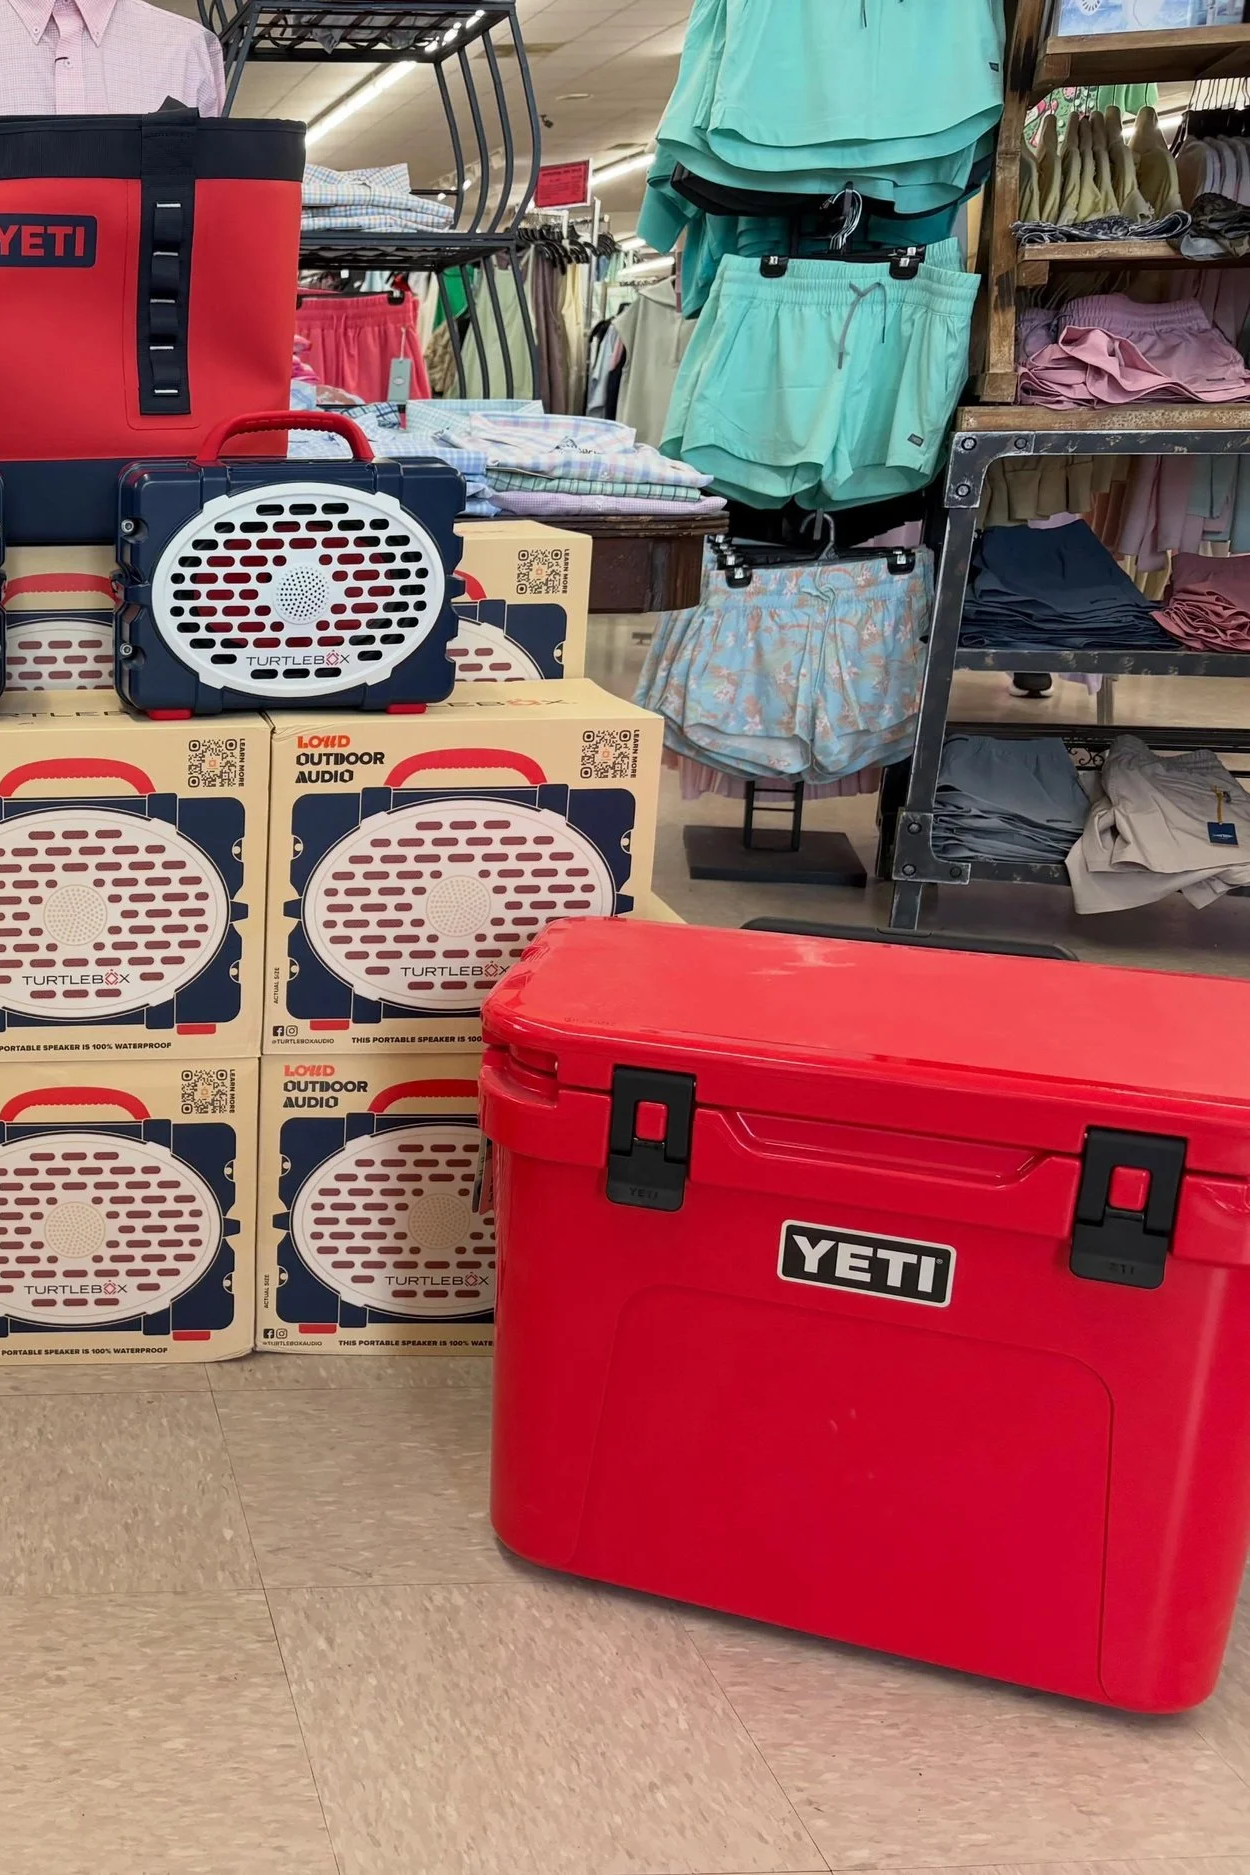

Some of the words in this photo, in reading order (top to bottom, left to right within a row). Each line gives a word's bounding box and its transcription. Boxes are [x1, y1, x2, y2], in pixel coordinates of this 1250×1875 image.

[561, 573, 569, 594] MORE
[245, 649, 350, 667] TURTLEBOX
[297, 735, 350, 749] LOUD
[296, 752, 385, 766] OUTDOOR
[295, 769, 354, 784] AUDIO
[400, 962, 510, 978] TURTLEBOX
[22, 970, 130, 986] TURTLEBOX
[82, 1043, 90, 1051] IS
[91, 1043, 113, 1051] 100%
[114, 1042, 172, 1050] WATERPROOF
[284, 1064, 335, 1077] LOUD
[283, 1080, 368, 1093] OUTDOOR
[282, 1095, 339, 1108] AUDIO
[630, 1187, 659, 1200] YETI
[792, 1235, 936, 1293] YETI
[384, 1273, 489, 1287] TURTLEBOX
[23, 1281, 128, 1295] TURTLEBOX
